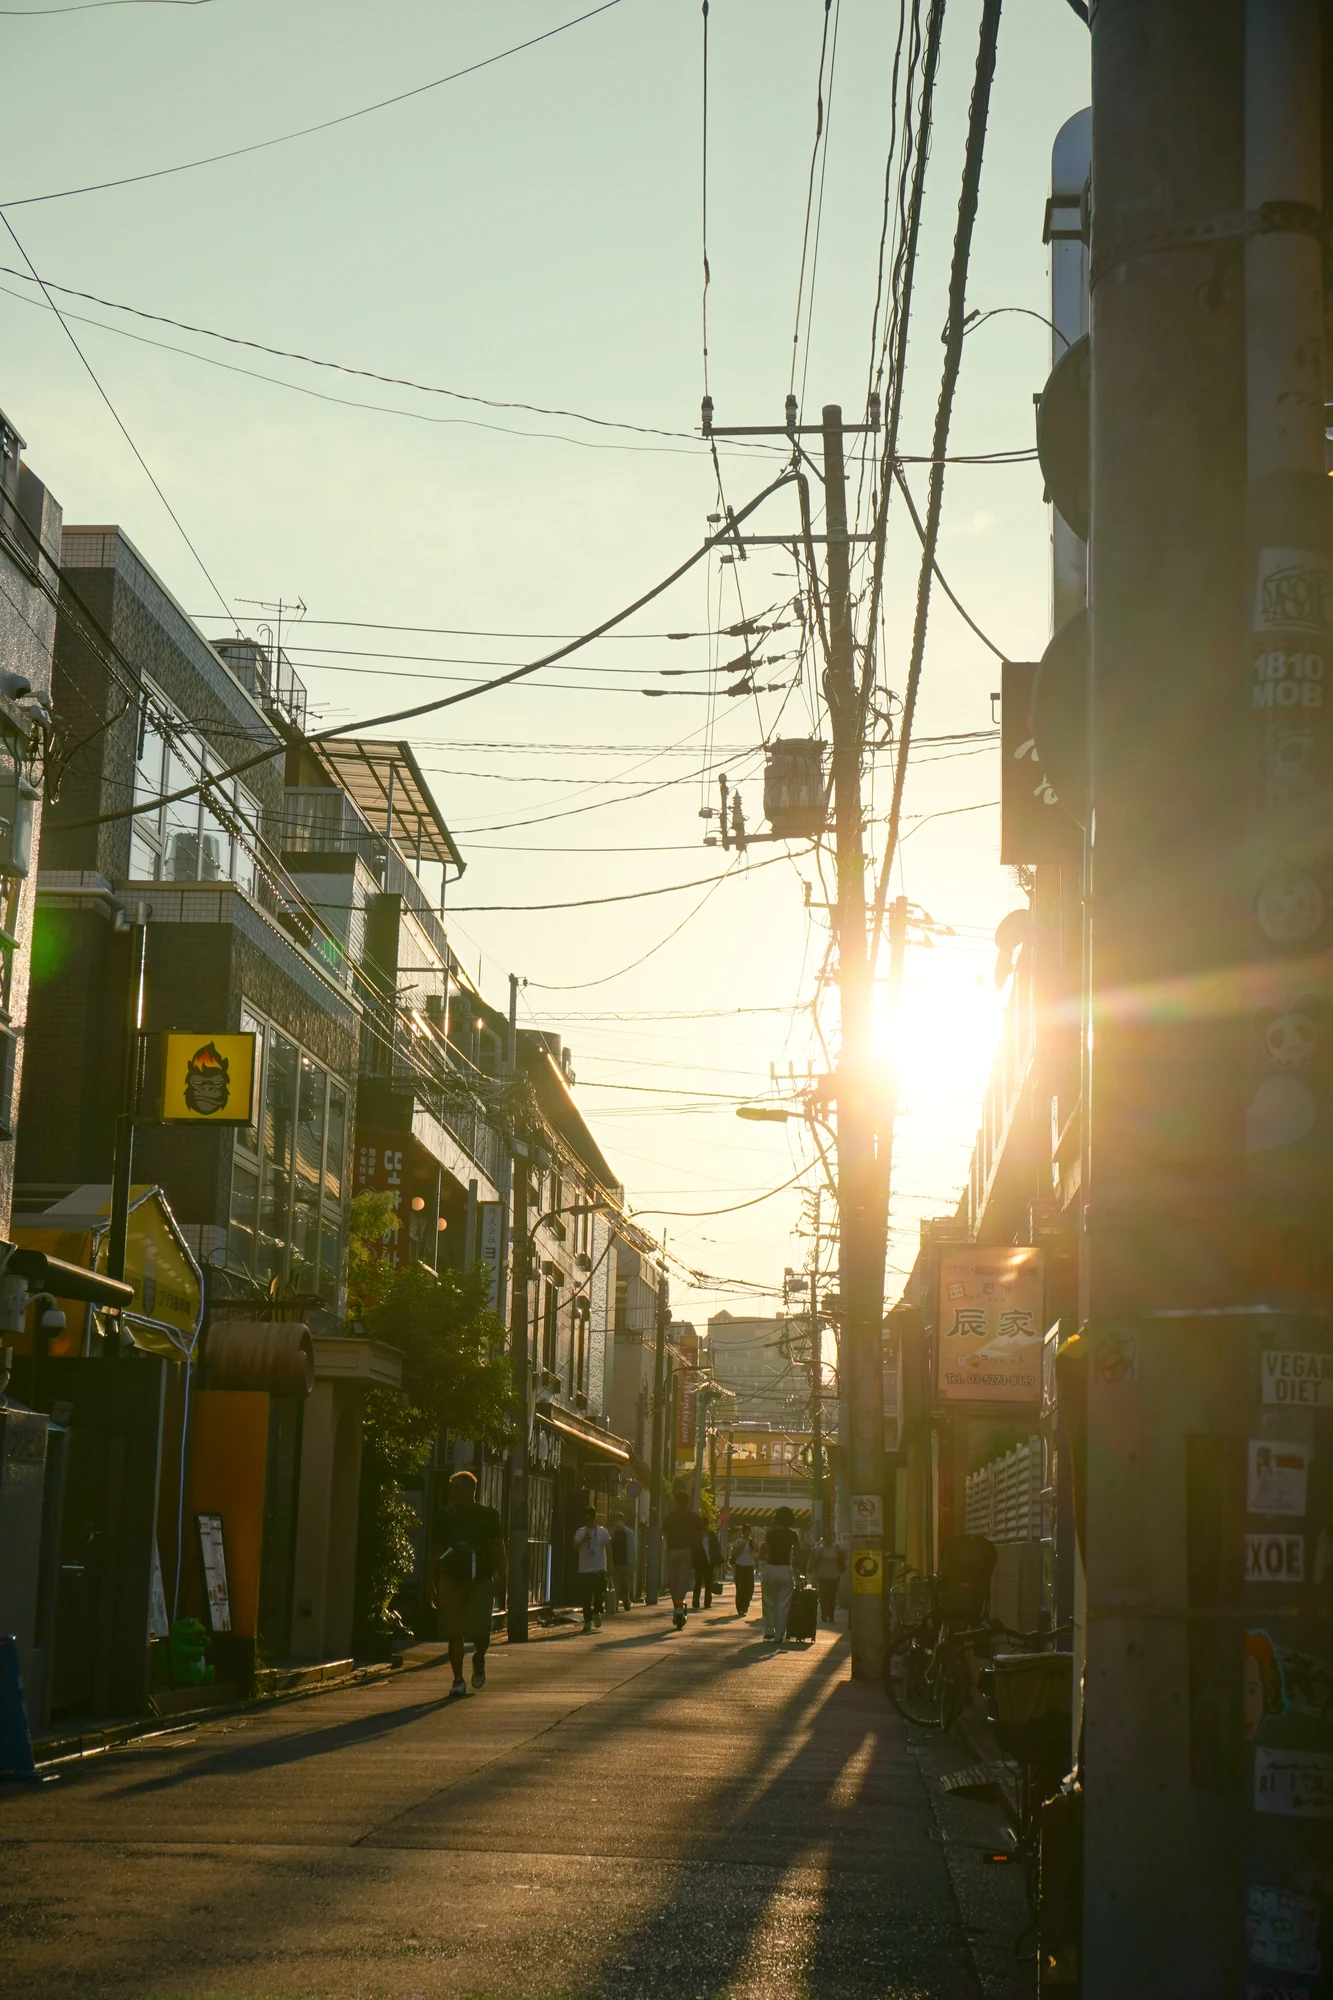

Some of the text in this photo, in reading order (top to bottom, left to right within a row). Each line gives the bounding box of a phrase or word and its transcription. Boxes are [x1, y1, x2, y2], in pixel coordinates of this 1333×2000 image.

[1254, 652, 1324, 681] 1810
[1253, 680, 1323, 709] MOB
[945, 1309, 1036, 1339] 辰家
